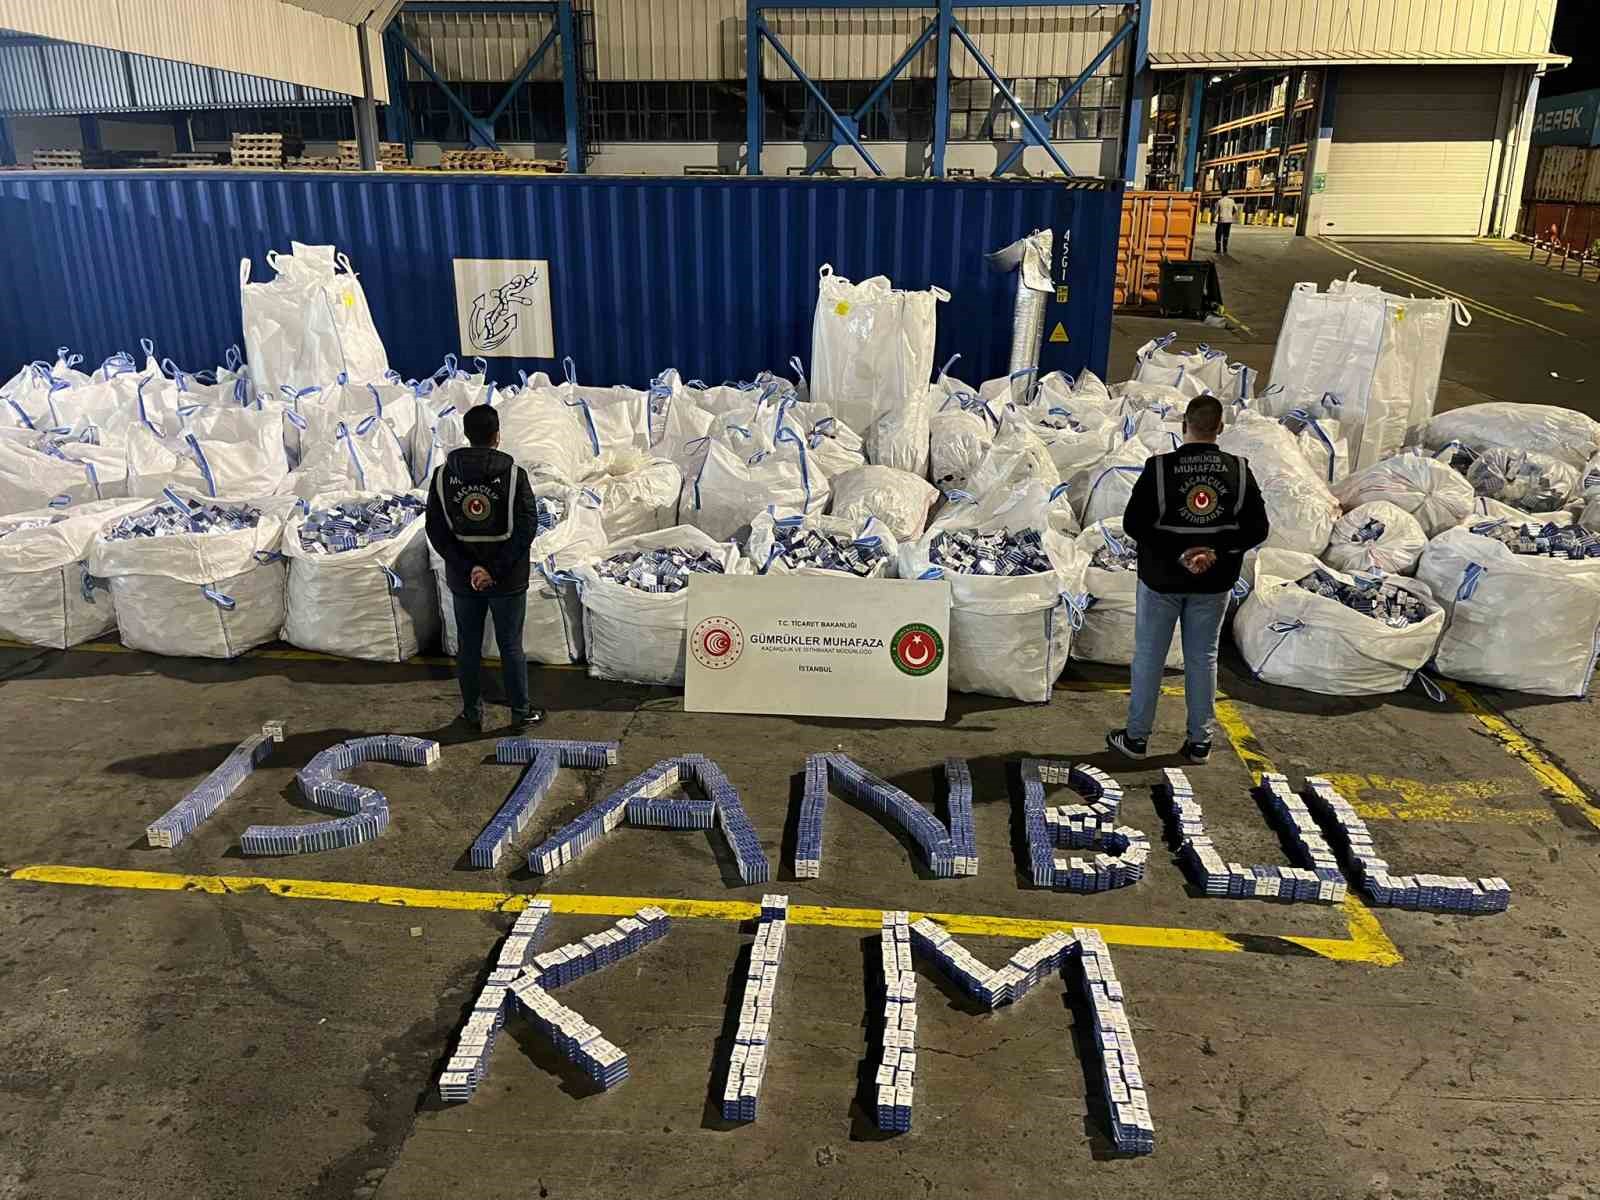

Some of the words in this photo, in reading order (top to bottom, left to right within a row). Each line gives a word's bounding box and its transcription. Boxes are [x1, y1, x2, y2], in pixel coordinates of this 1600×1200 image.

[1534, 106, 1584, 132] AERSK
[1174, 463, 1228, 474] MUHAFAZA
[750, 632, 821, 646] GÜMRÜKLER
[823, 636, 884, 648] MUHAFAZA
